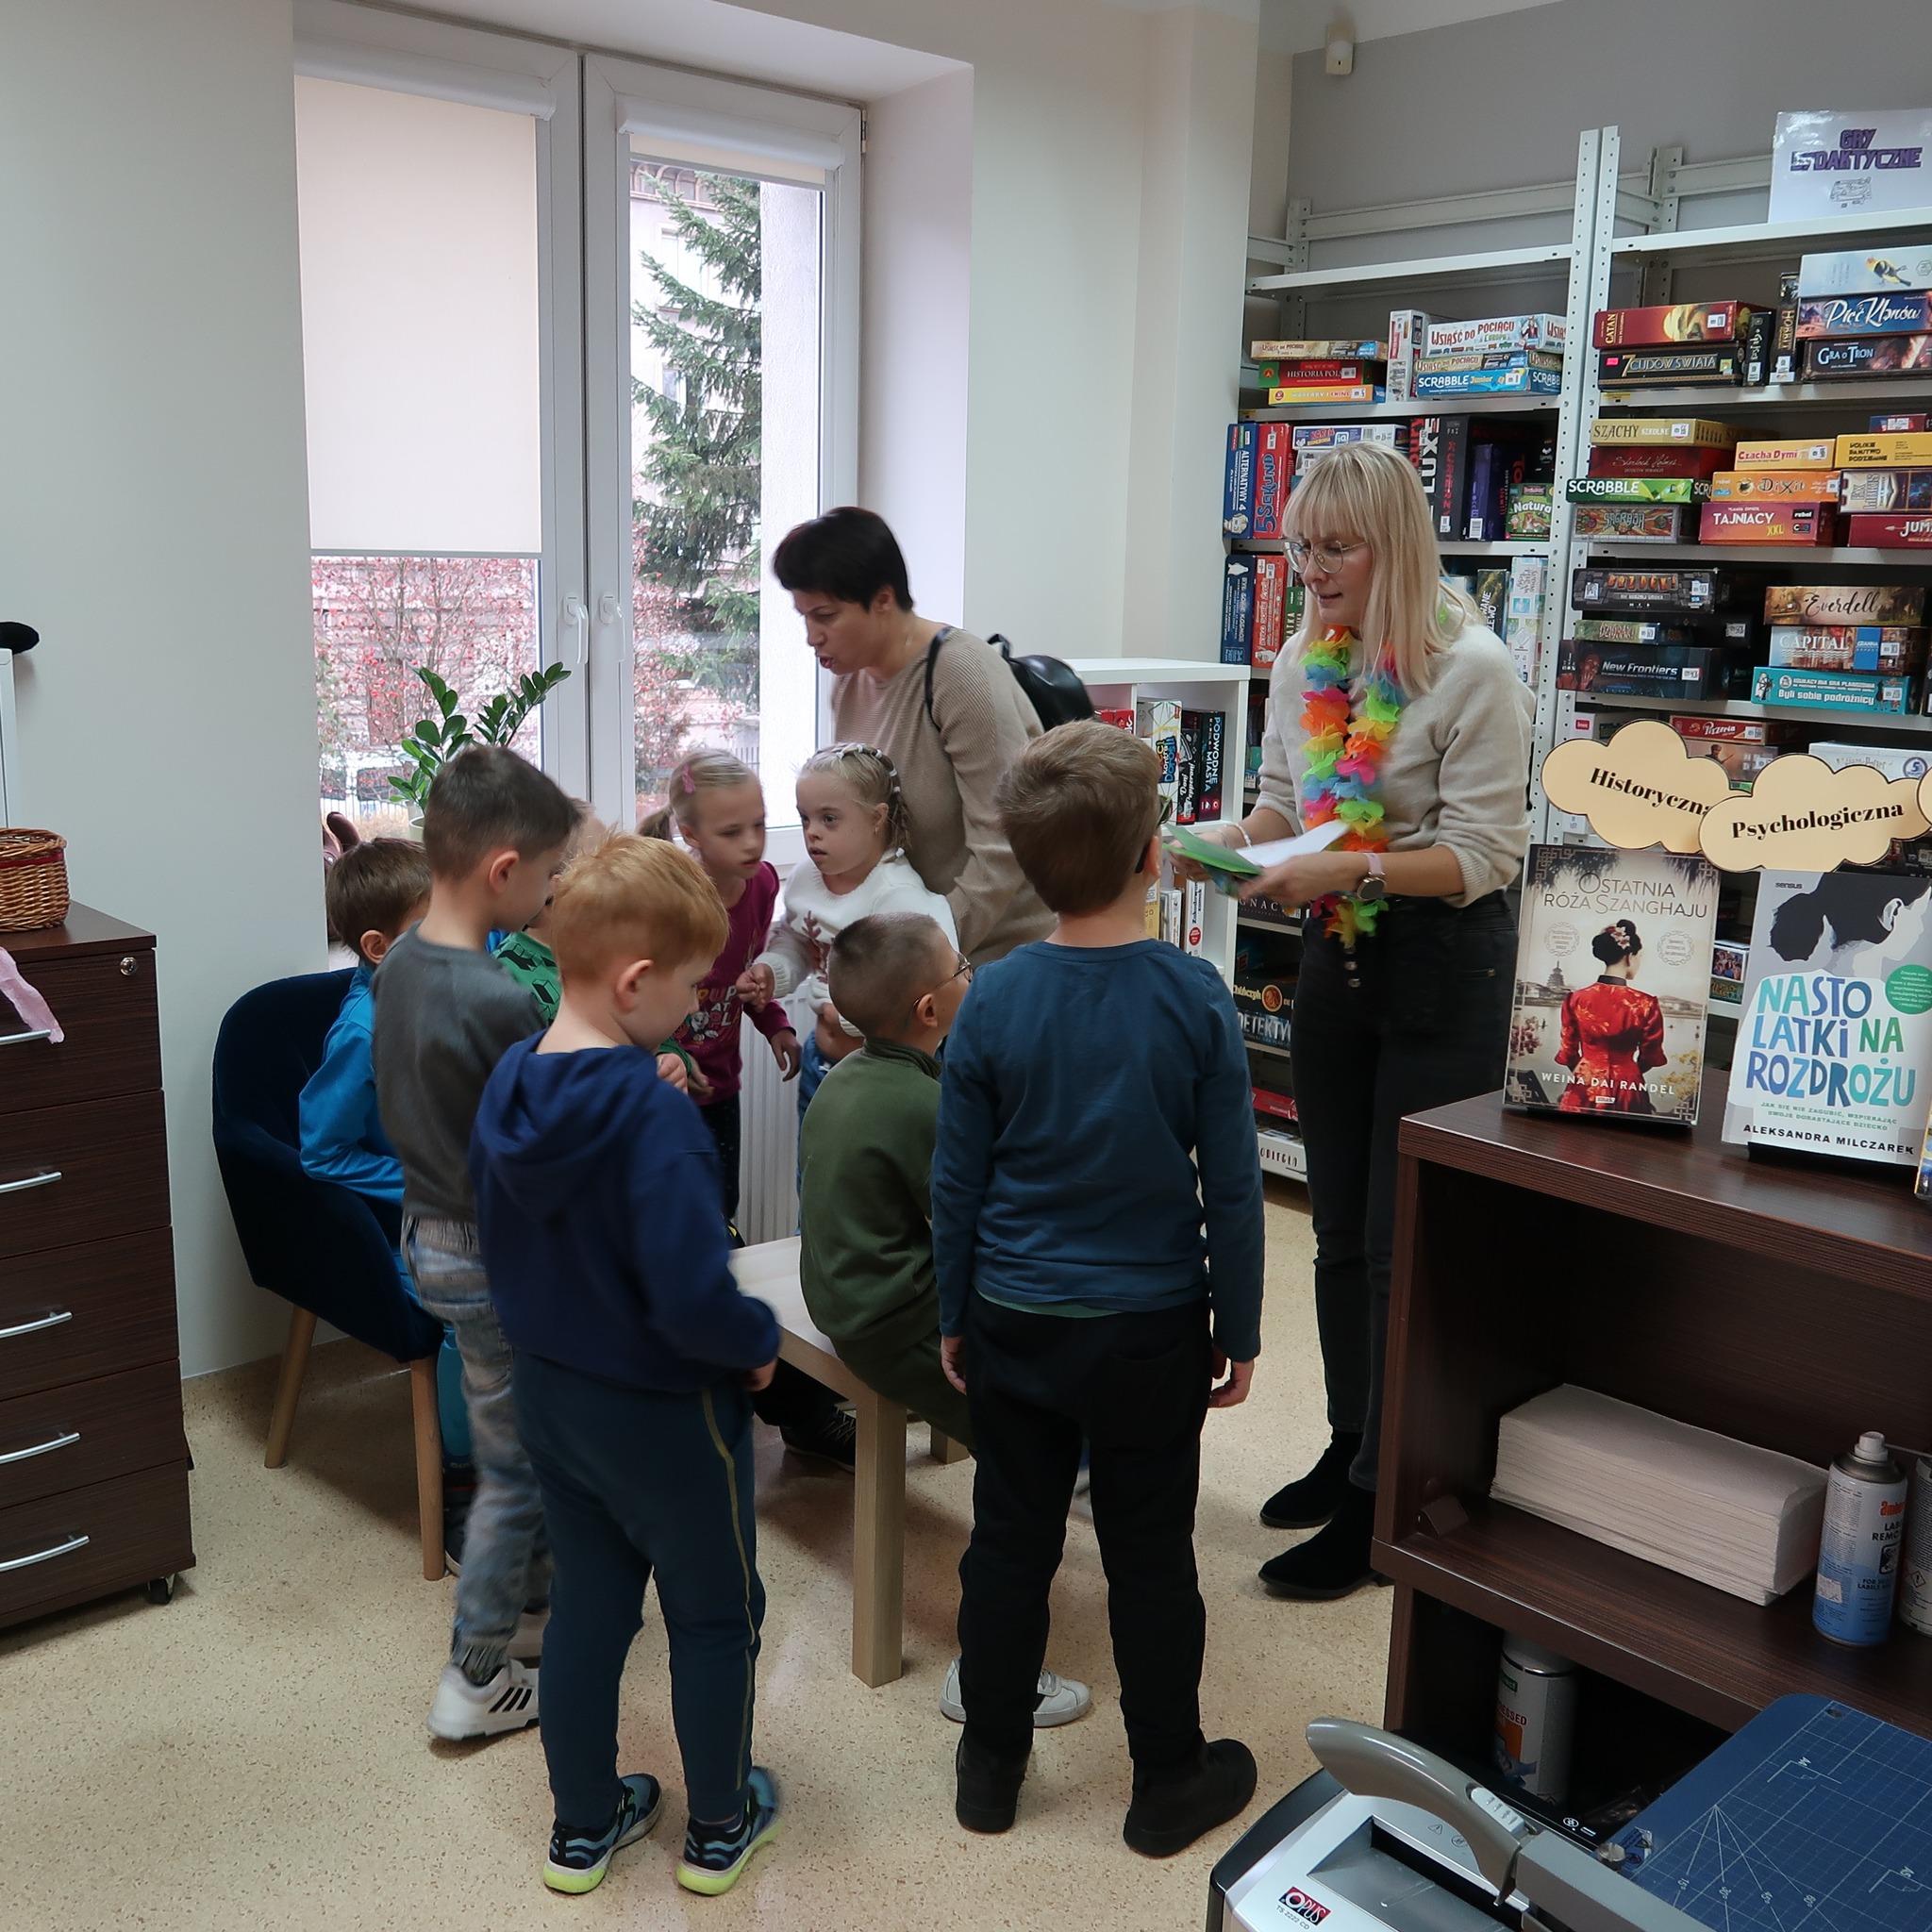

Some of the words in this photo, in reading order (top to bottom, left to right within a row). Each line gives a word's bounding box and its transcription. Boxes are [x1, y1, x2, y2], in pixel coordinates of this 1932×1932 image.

[1840, 128, 1877, 149] GRY
[1464, 330, 1475, 341] DO
[1606, 313, 1616, 344] CATAN
[1621, 354, 1637, 377] 7
[1418, 375, 1470, 389] SCRABBLE
[1593, 425, 1640, 441] SZACHY
[1739, 451, 1772, 459] Czacha
[1774, 450, 1797, 459] Dymi
[1239, 450, 1250, 503] ALTERNATYWY
[1257, 453, 1277, 518] SEKUND
[1568, 479, 1640, 495] SCRABBLE
[1513, 501, 1552, 513] Natura
[1255, 516, 1277, 533] 5
[1713, 512, 1774, 525] TAJNIACY
[1766, 525, 1784, 536] XXL
[1804, 591, 1881, 618] Everdell
[1779, 635, 1850, 650] CAPITAL
[1602, 661, 1625, 671] New
[1627, 662, 1678, 675] Frontiers
[1778, 690, 1795, 700] Byli
[1797, 691, 1822, 700] sobie
[1212, 716, 1222, 784] PODWODNE
[1204, 751, 1213, 791] MIASTA
[1732, 804, 1905, 841] Psychologiczna
[1578, 872, 1675, 897] OSTATNIA
[1543, 891, 1591, 910] RÓŻA
[1595, 895, 1708, 919] SZANGHAJU
[711, 1002, 730, 1011] AT
[1757, 975, 1873, 1020] NASTO
[1752, 1014, 1849, 1058] LATKI
[1859, 1017, 1904, 1053] NA
[1541, 1073, 1585, 1086] WEINA
[1591, 1077, 1614, 1089] DAI
[1620, 1080, 1674, 1095] RANDEL
[1745, 1051, 1916, 1108] ROZDROŻU
[1848, 1113, 1898, 1124] WSPIERAJĄC
[1854, 1122, 1888, 1131] DZIECKO
[1743, 1124, 1830, 1143] ALEKSANDRA
[1836, 1136, 1915, 1155] MILCZAREK
[1299, 1922, 1310, 1930] CD
